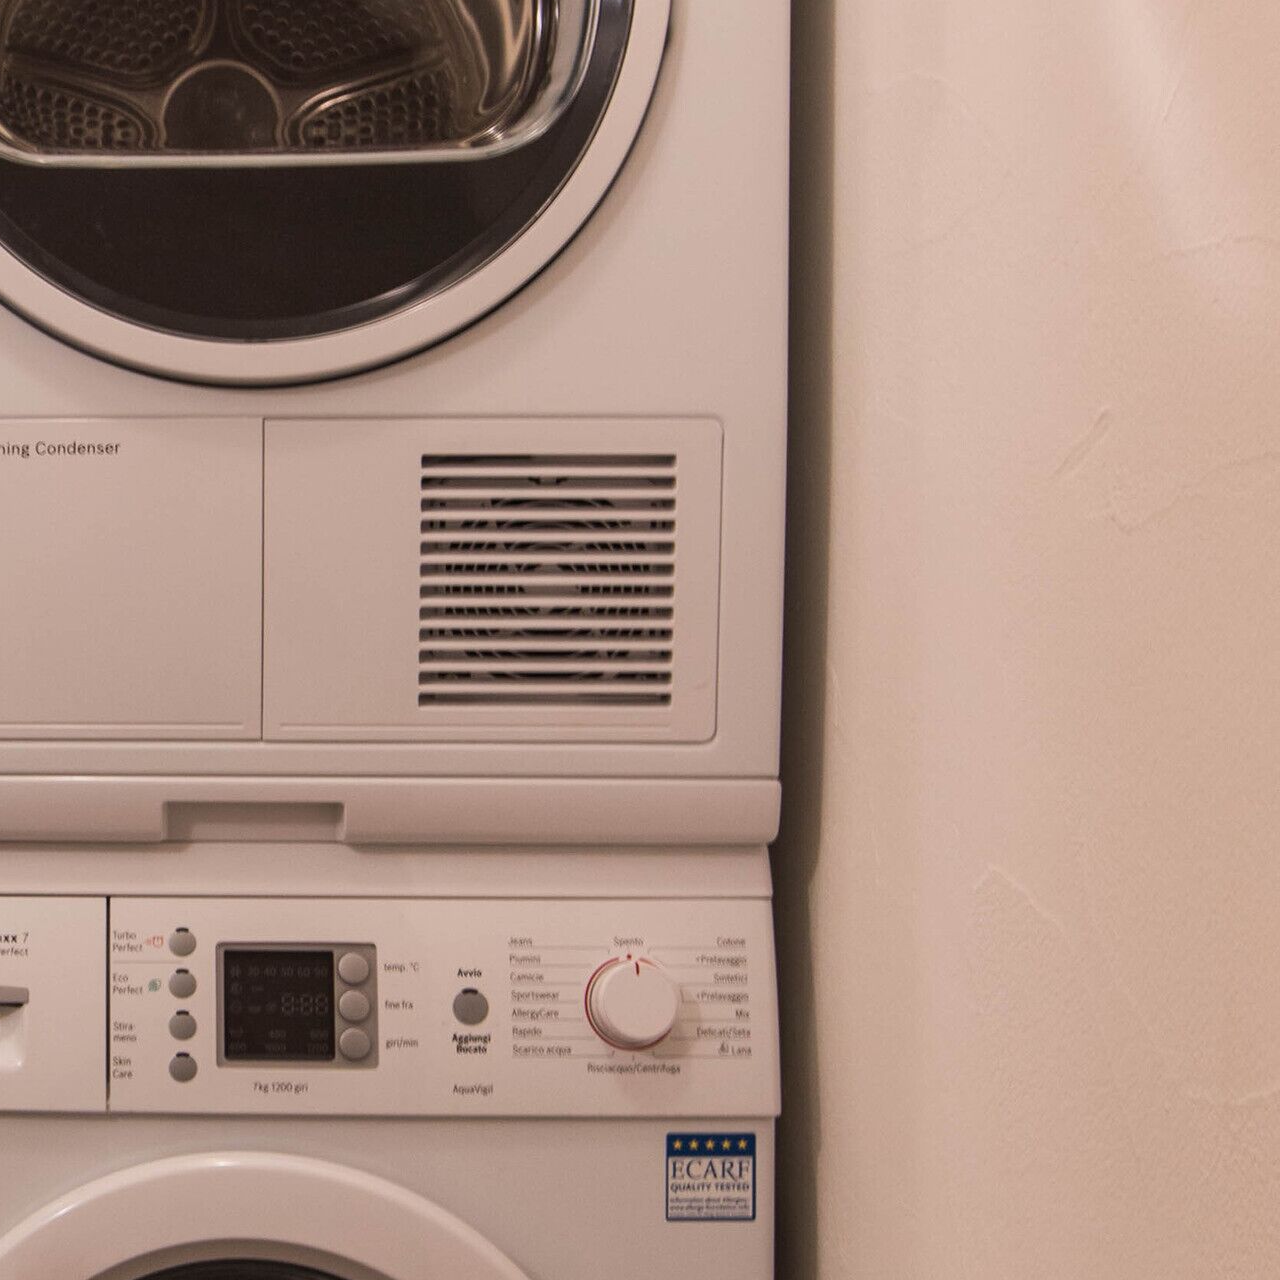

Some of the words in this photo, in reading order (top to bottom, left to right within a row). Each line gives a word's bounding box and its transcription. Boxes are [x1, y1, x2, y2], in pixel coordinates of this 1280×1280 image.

[35, 440, 121, 456] Condenser
[23, 932, 29, 943] 7
[113, 931, 136, 940] Turbo
[716, 936, 746, 946] Cotone
[112, 942, 143, 952] Perfect
[613, 936, 644, 948] Spento
[112, 973, 129, 982] Eco
[457, 968, 482, 978] Avvio
[510, 972, 544, 981] Camicie
[112, 985, 143, 995] Perfect
[511, 990, 560, 1001] Sportswear
[385, 1000, 400, 1010] fine
[402, 1000, 413, 1010] fra
[511, 1008, 559, 1020] AllergyCare
[735, 1010, 750, 1019] Mix
[512, 1026, 542, 1037] Rapido
[386, 1037, 419, 1049] giri/min
[451, 1033, 492, 1045] Aggiungi
[512, 1044, 545, 1054] Scarico
[546, 1046, 572, 1057] acqua
[731, 1045, 752, 1055] Lana
[112, 1055, 132, 1066] Skin
[586, 1063, 681, 1075] Risciacquo/Centrifuga
[112, 1070, 133, 1080] Care
[272, 1081, 292, 1092] 1200
[294, 1082, 309, 1094] giri
[453, 1084, 494, 1096] AquaVigil
[671, 1160, 750, 1181] ECARF
[670, 1182, 711, 1193] QUALITY
[714, 1181, 750, 1191] TESTED
